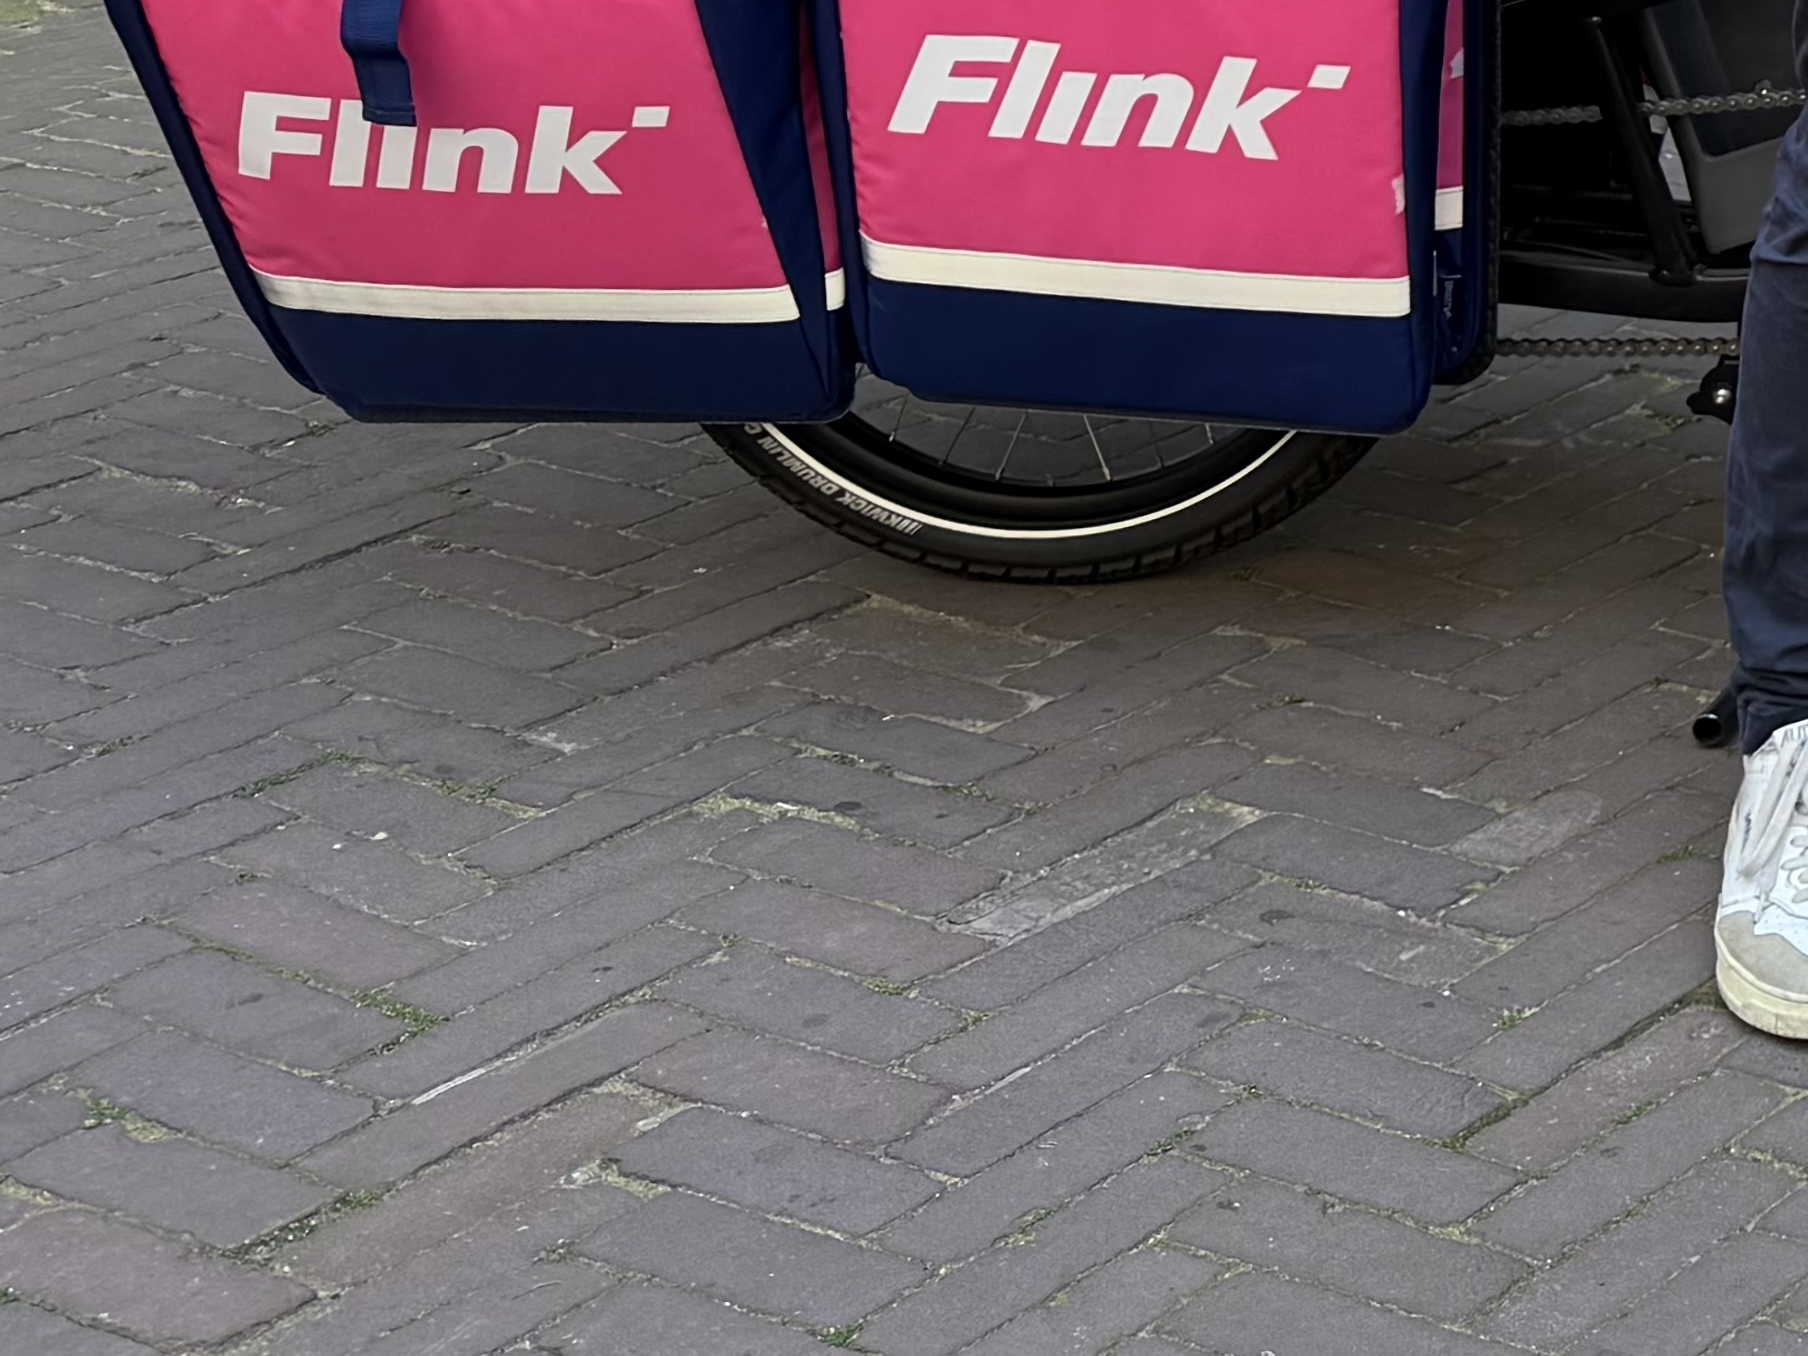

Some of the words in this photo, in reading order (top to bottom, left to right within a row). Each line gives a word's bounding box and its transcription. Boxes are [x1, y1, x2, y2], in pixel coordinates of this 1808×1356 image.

[235, 91, 670, 196] Flink
[886, 33, 1351, 162] Flink
[756, 436, 841, 495] DRUMLIN
